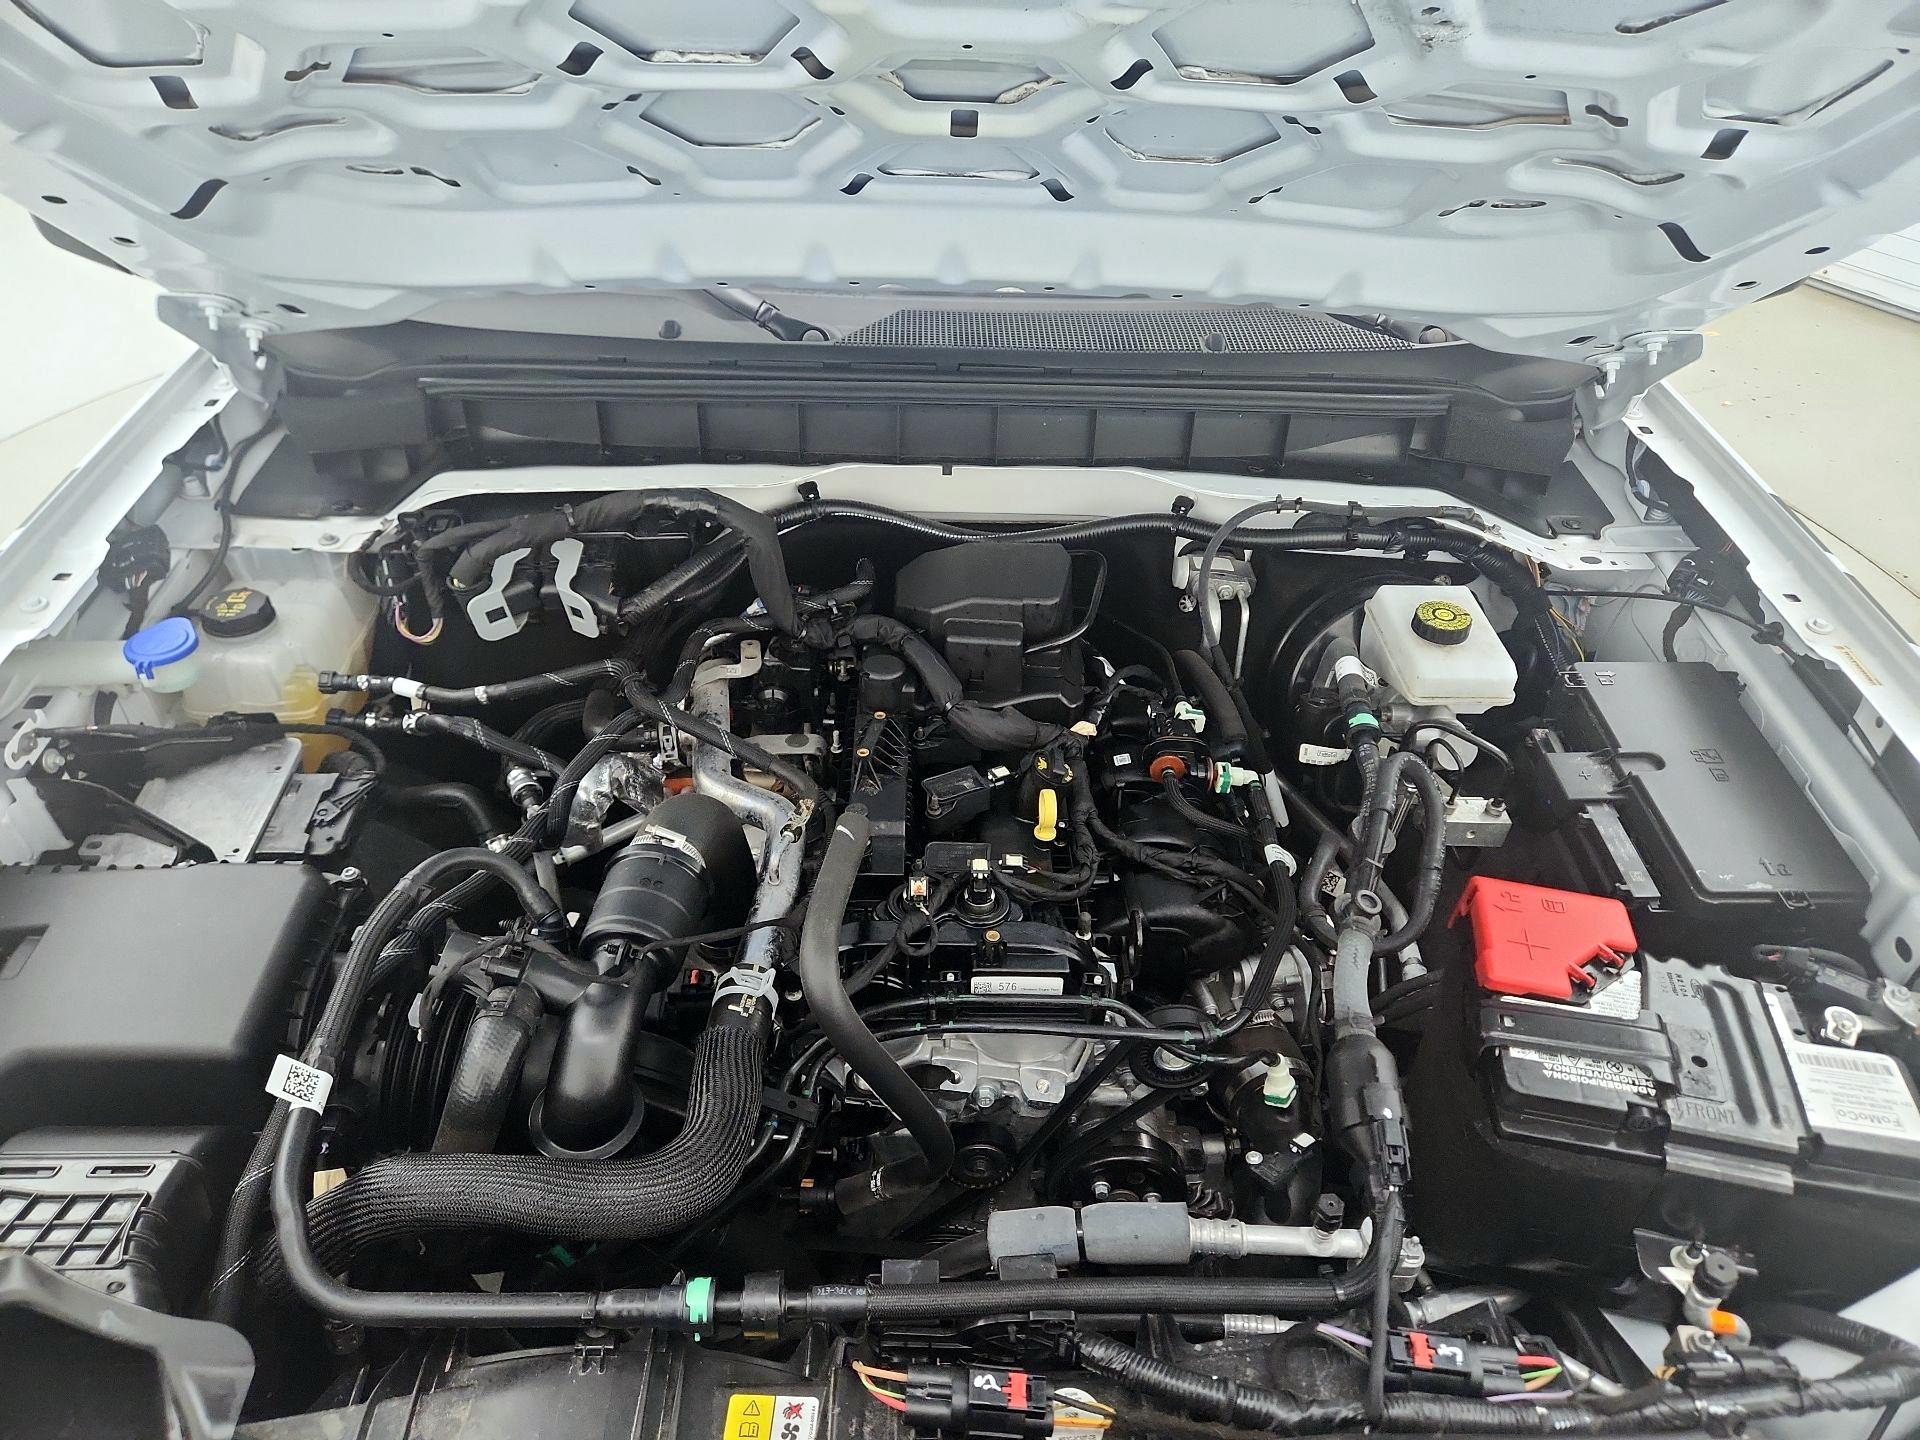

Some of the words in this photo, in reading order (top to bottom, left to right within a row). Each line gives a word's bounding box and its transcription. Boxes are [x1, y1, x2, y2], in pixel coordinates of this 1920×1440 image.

[998, 982, 1017, 991] 576
[1685, 1102, 1736, 1124] FRONT
[1837, 1109, 1903, 1128] FoMoCo
